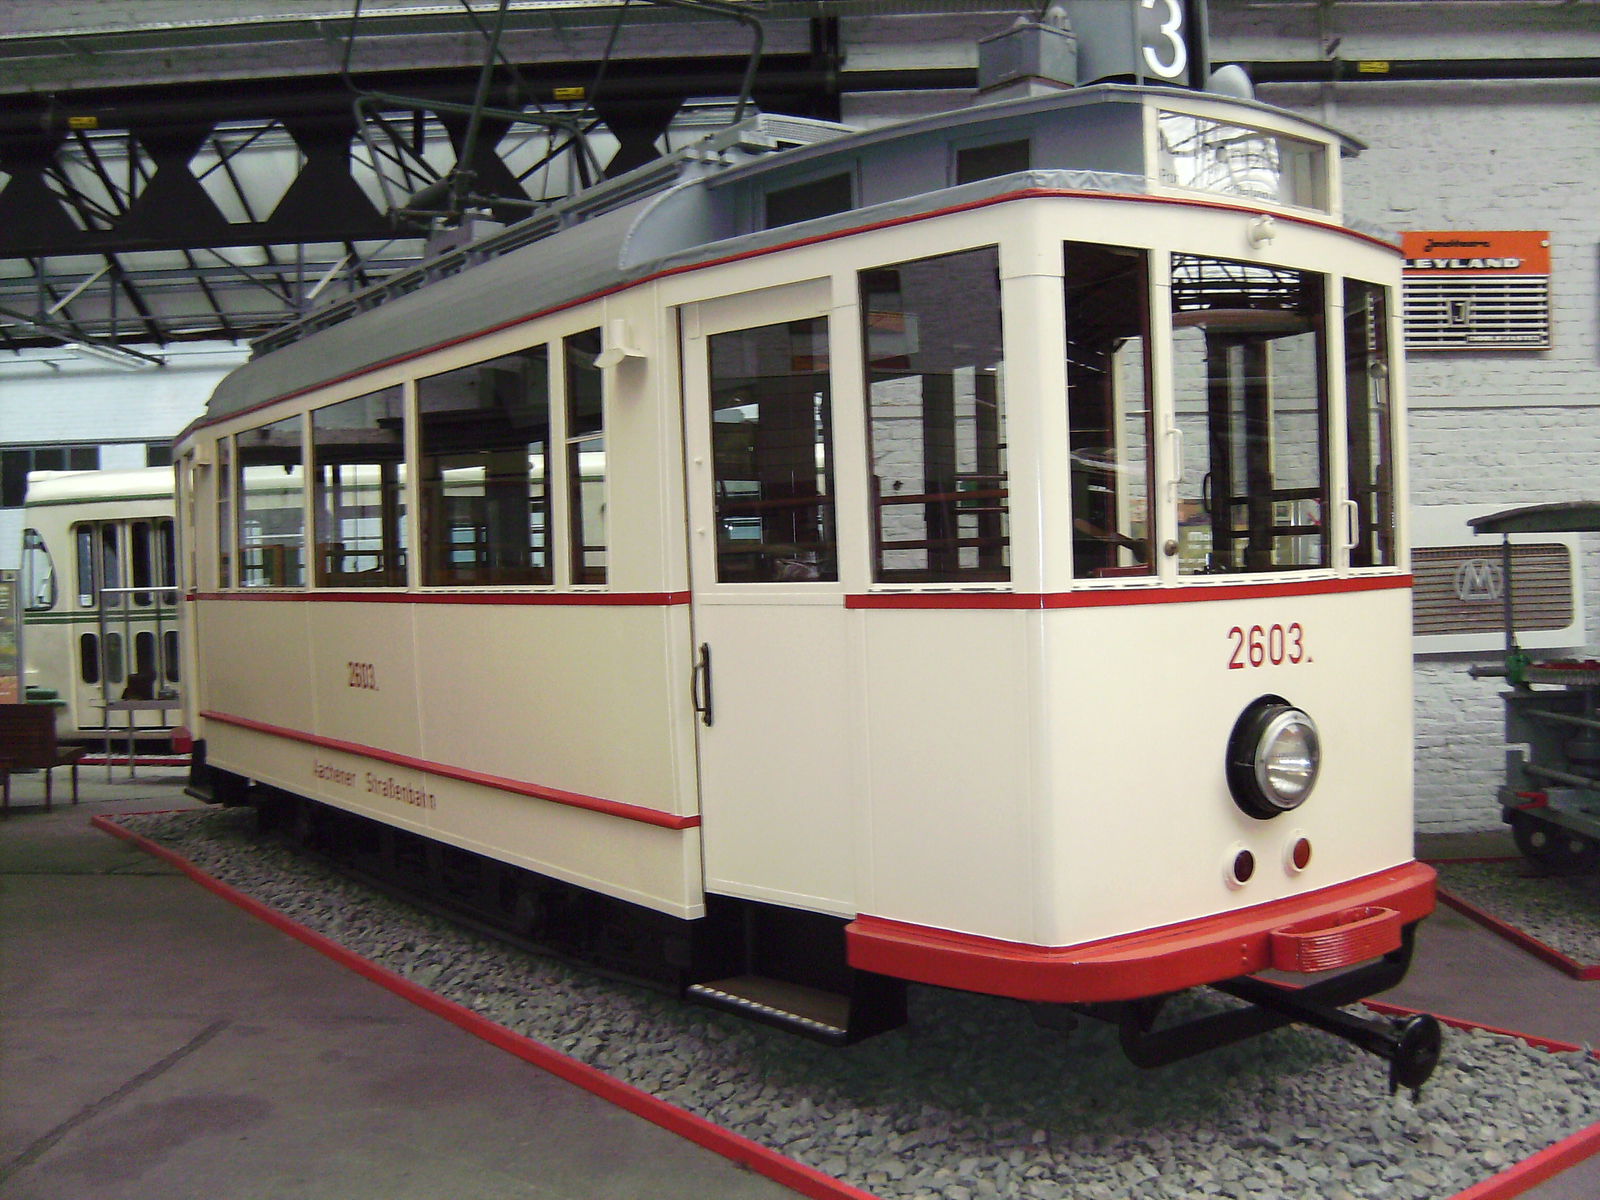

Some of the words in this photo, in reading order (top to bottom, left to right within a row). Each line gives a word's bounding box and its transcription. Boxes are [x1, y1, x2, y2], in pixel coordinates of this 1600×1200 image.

[1141, 0, 1187, 78] 3
[1401, 258, 1521, 269] LEYLAND
[313, 759, 357, 787] Aachener
[366, 772, 437, 810] Straßenbahn
